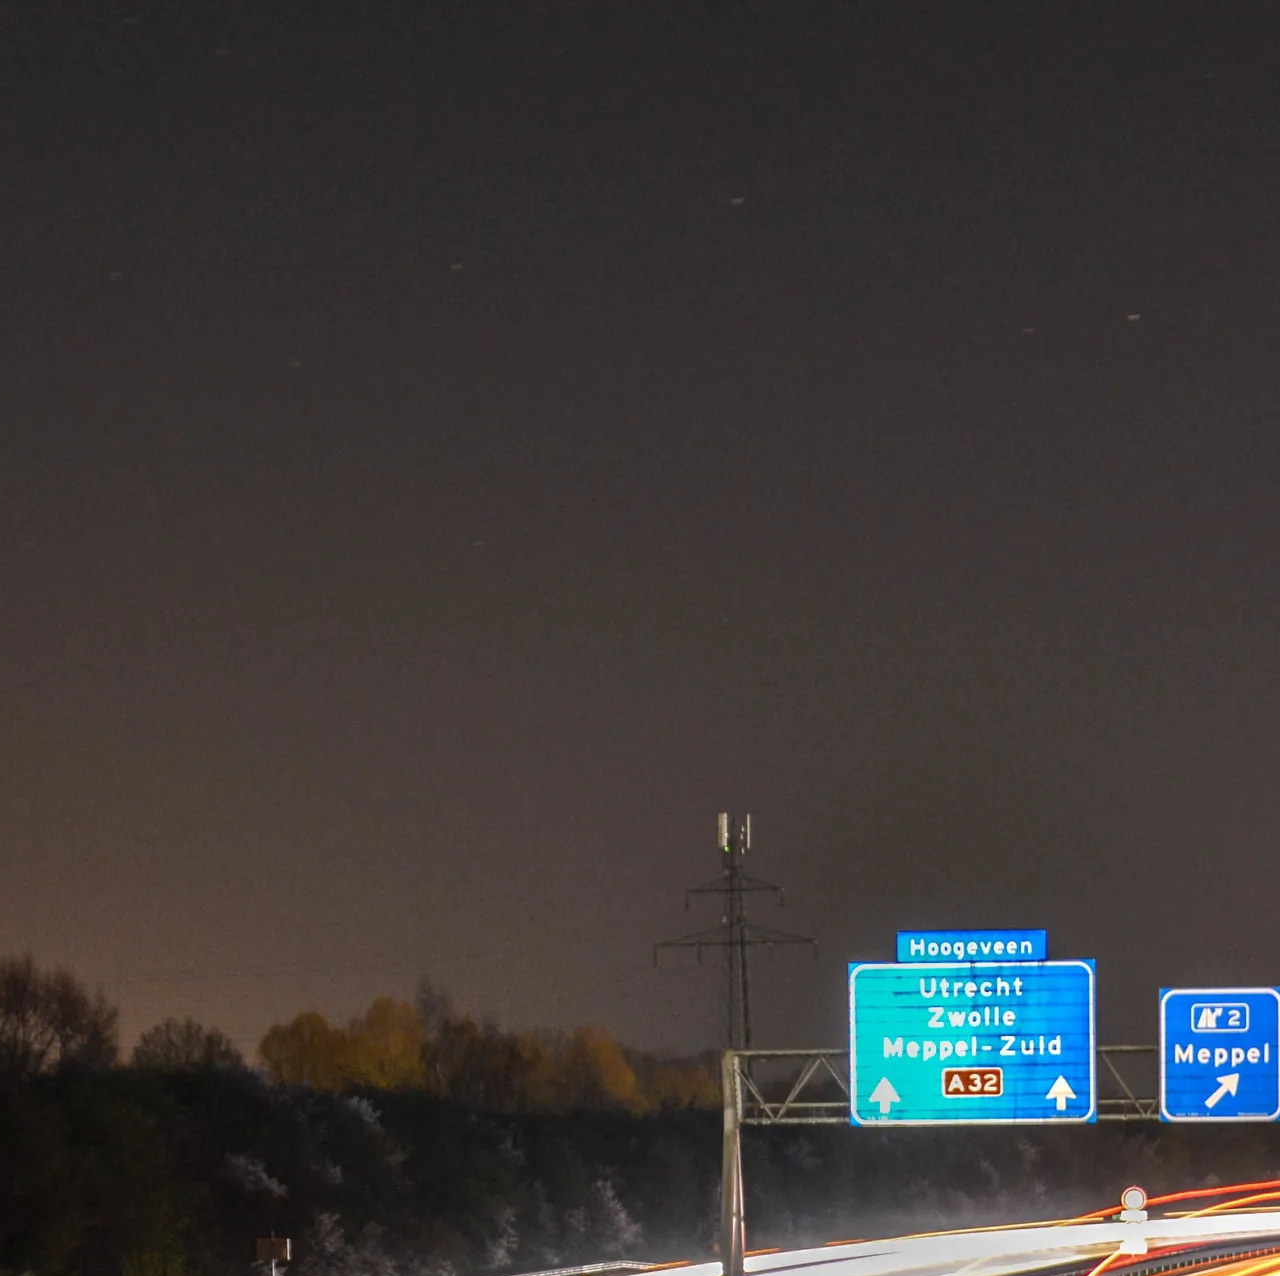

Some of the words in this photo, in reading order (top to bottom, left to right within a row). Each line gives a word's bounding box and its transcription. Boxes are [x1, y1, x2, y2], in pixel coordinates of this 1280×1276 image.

[910, 938, 1033, 959] Hoogeveen
[920, 977, 1023, 998] Utrecht
[928, 1006, 1016, 1028] Zwolle
[1228, 1009, 1241, 1026] 2
[1175, 1042, 1270, 1068] Meppel
